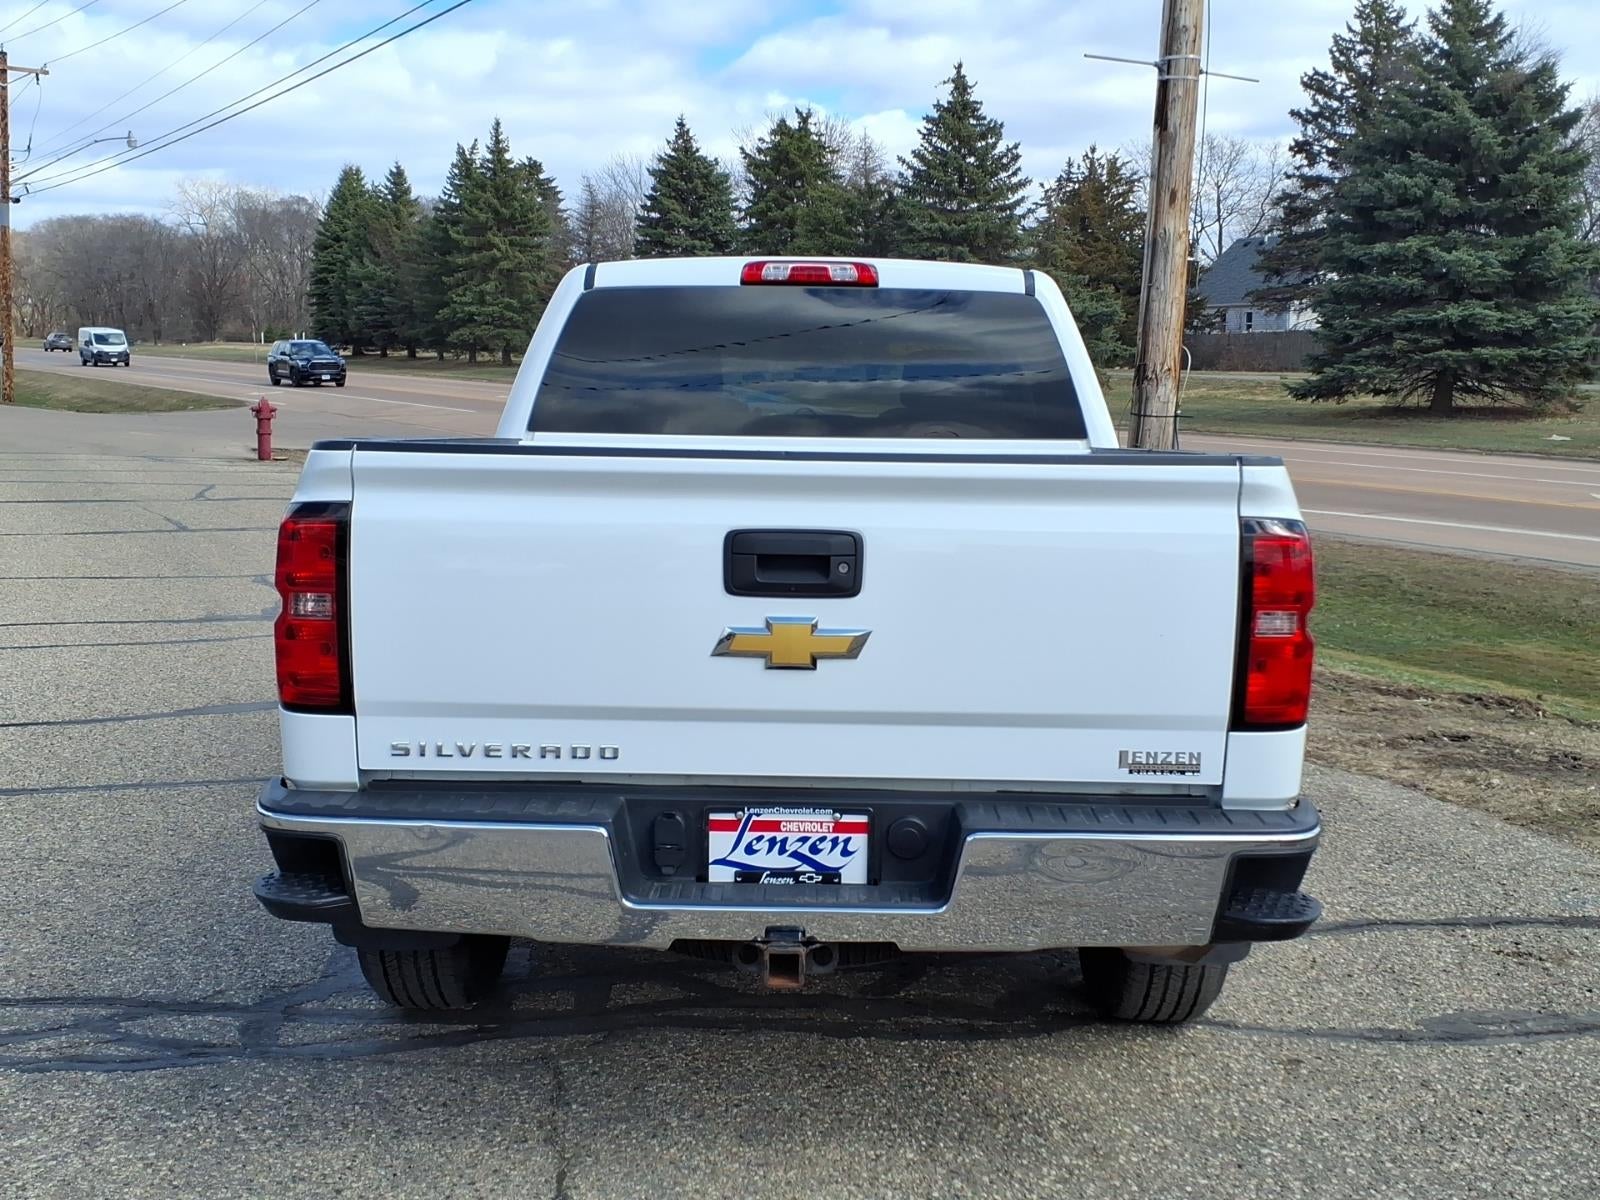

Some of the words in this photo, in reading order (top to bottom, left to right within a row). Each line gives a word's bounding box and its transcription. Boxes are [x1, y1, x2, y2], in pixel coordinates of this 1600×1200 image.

[390, 741, 620, 760] SILVERADO
[1119, 750, 1201, 769] LENZEN
[744, 806, 834, 816] LenzenChevrolet.com
[780, 821, 834, 833] CHEVROLET
[709, 813, 860, 872] Lenzen
[759, 872, 795, 885] Lenzen
